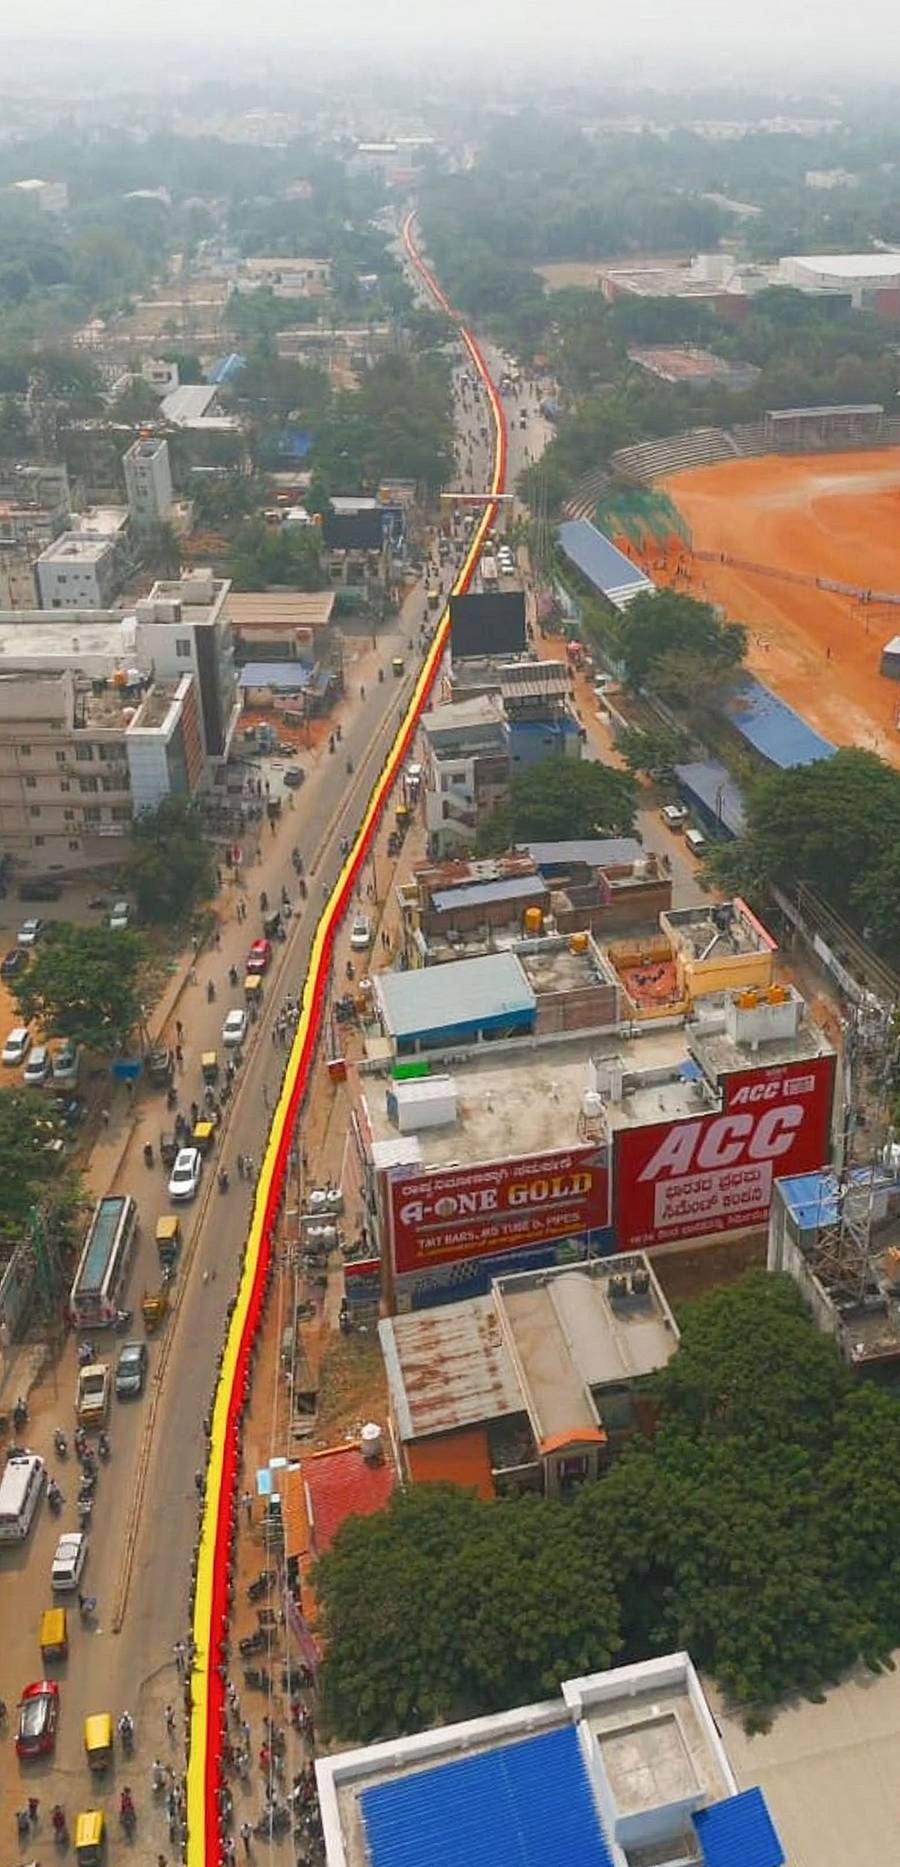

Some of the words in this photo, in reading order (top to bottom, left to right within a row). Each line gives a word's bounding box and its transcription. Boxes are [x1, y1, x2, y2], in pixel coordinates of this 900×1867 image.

[729, 1081, 781, 1106] ACC
[636, 1104, 804, 1183] ACC
[508, 1173, 592, 1205] GOLD
[417, 1237, 442, 1249] TMT
